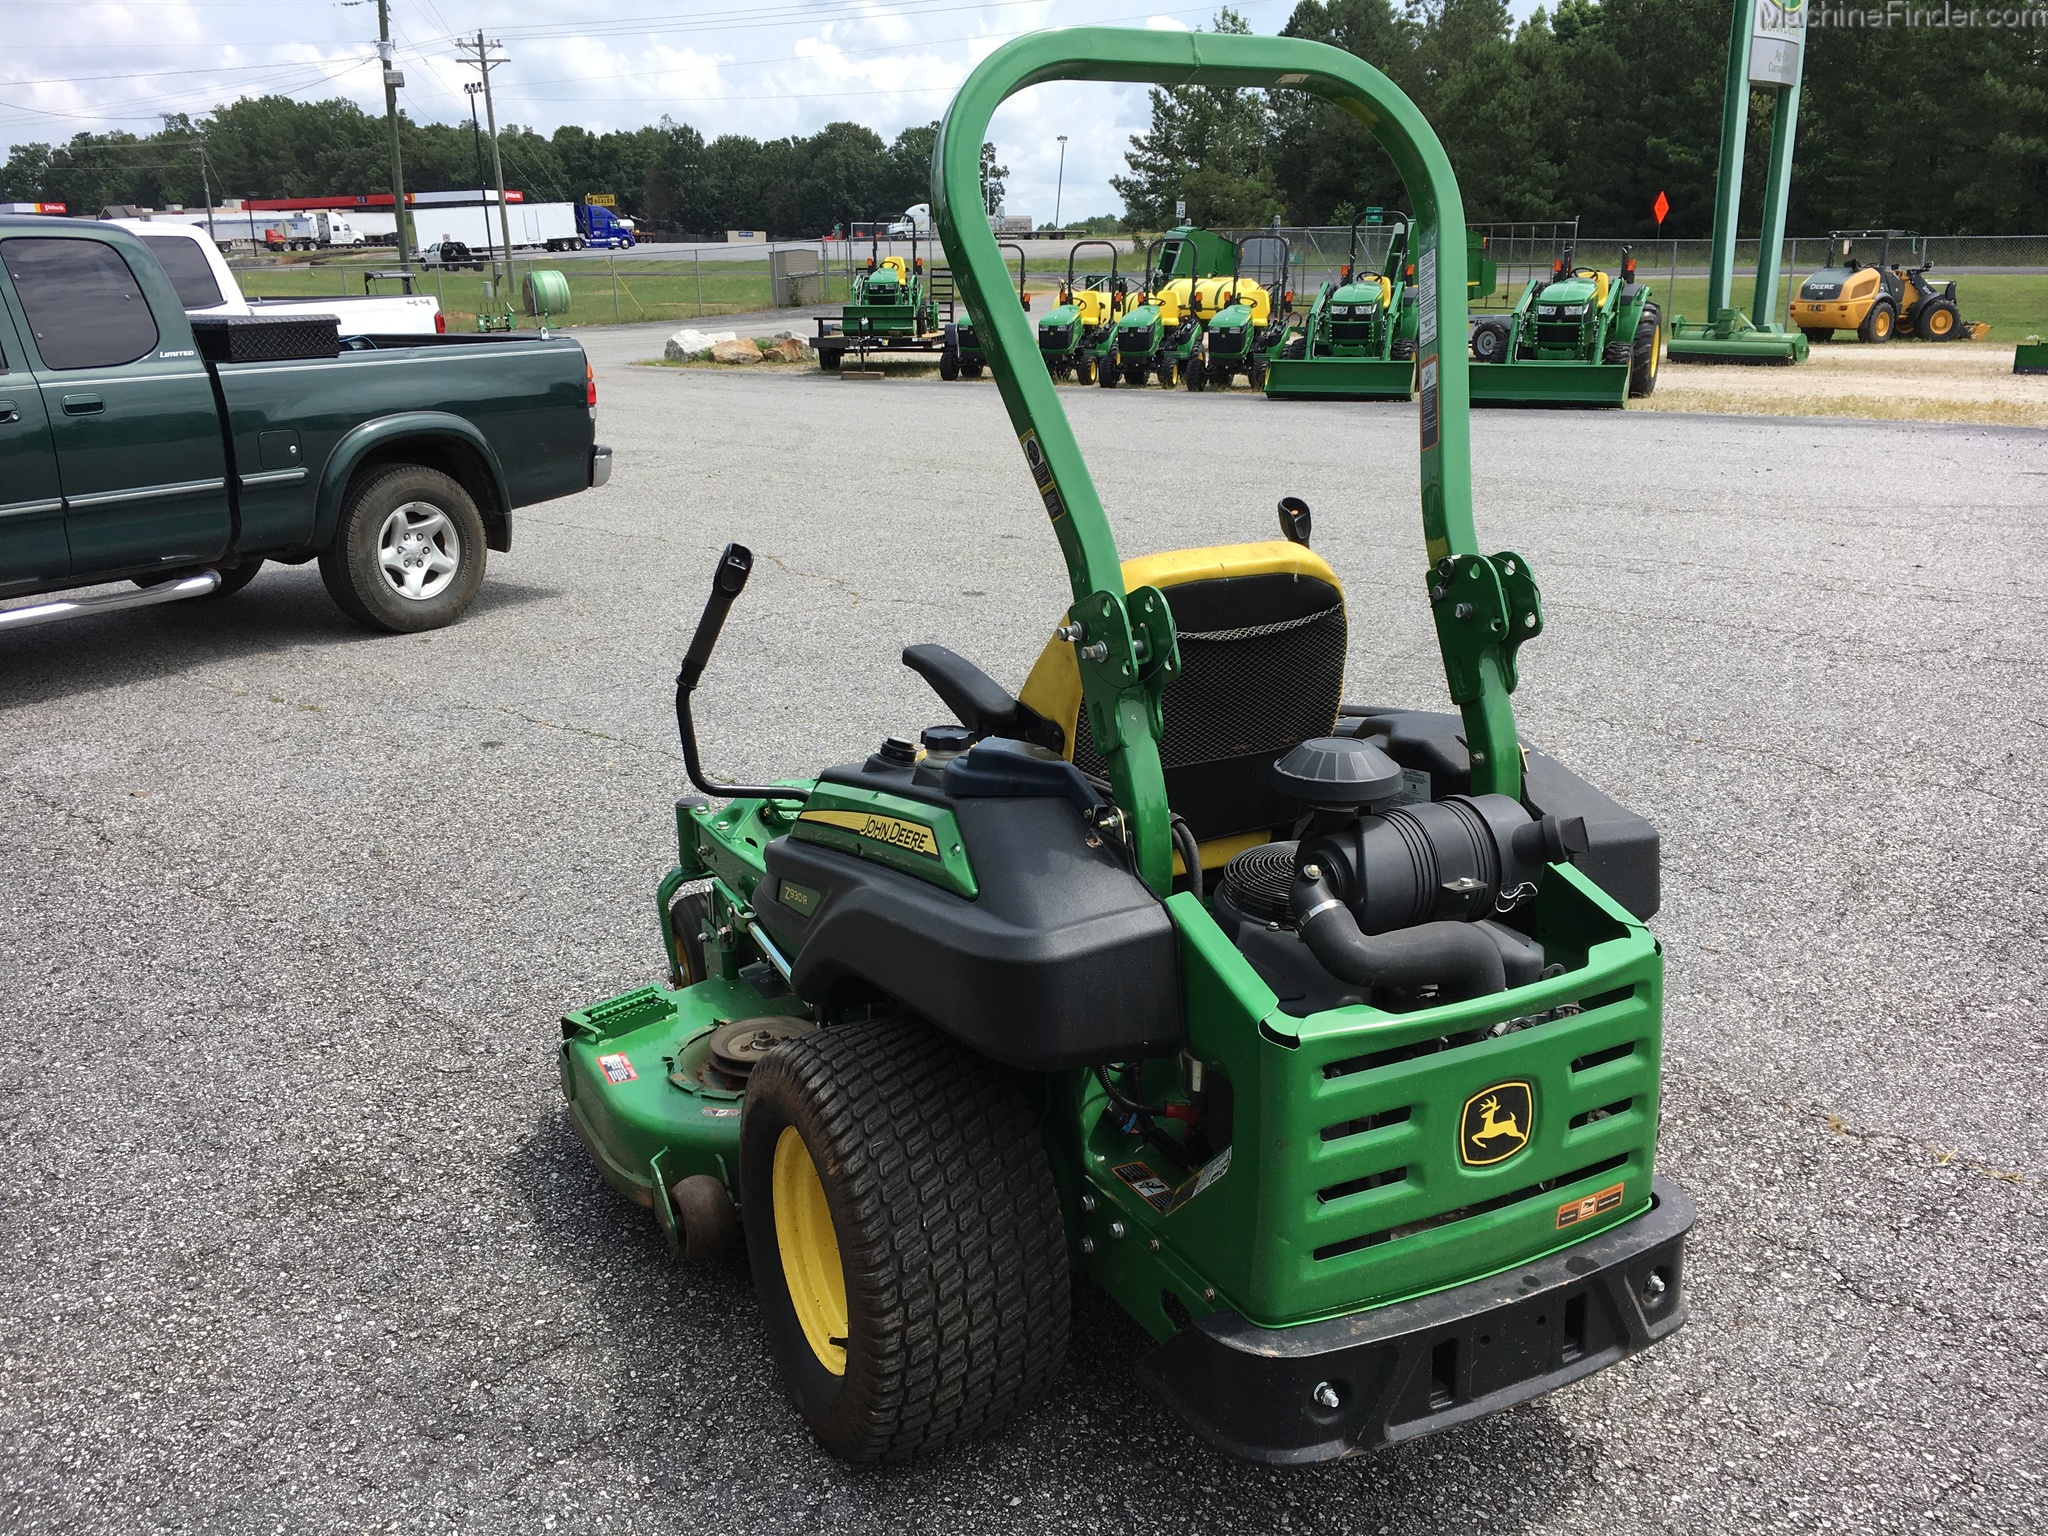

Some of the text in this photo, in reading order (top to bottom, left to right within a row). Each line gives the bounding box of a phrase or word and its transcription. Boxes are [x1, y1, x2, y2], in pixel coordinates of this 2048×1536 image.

[860, 816, 929, 850] JOHN DEERE
[784, 886, 808, 905] Z930R
